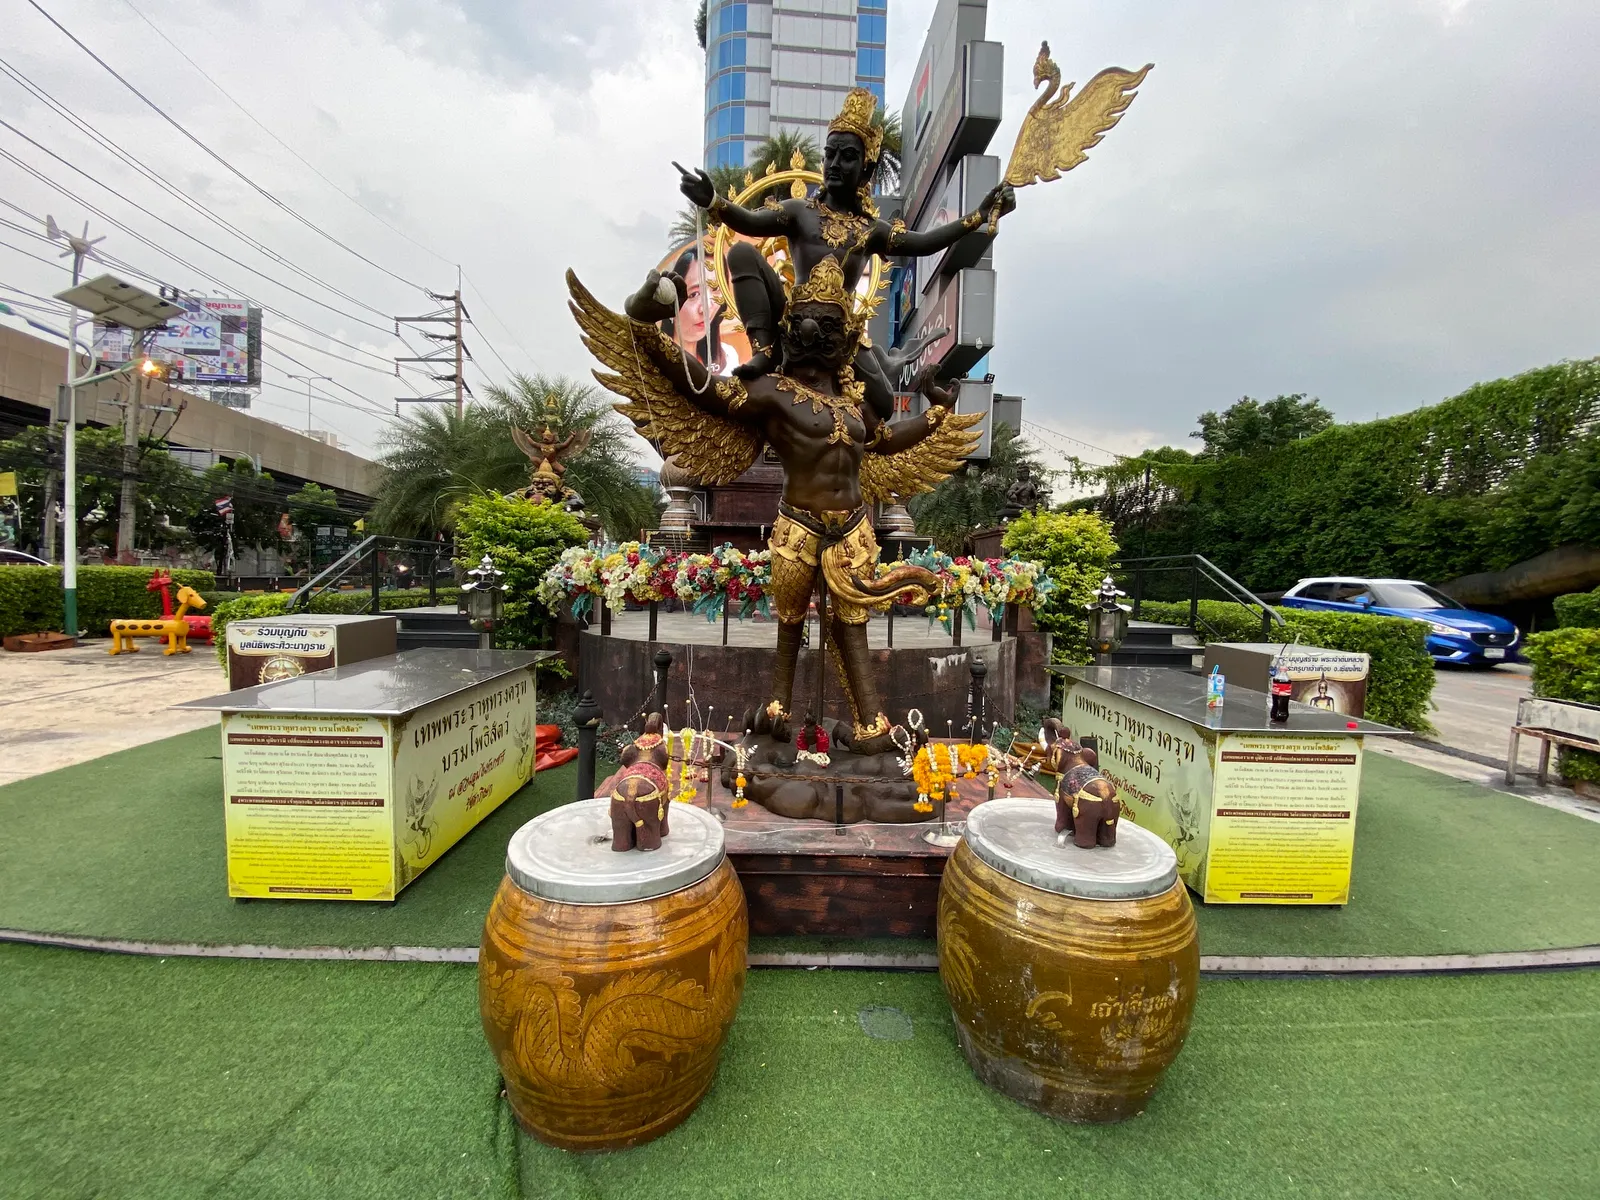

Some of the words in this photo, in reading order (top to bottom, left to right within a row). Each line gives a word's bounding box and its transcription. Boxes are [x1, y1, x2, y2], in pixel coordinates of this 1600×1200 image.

[168, 325, 216, 339] EXPO
[257, 625, 308, 639] ร่วมบุญกับ
[414, 680, 527, 749] เทพพระราหูทรงครุฑ
[441, 711, 510, 774] บรมโพธิสัตว์
[1075, 694, 1195, 767] เทพพระราหูทรงครุฑ
